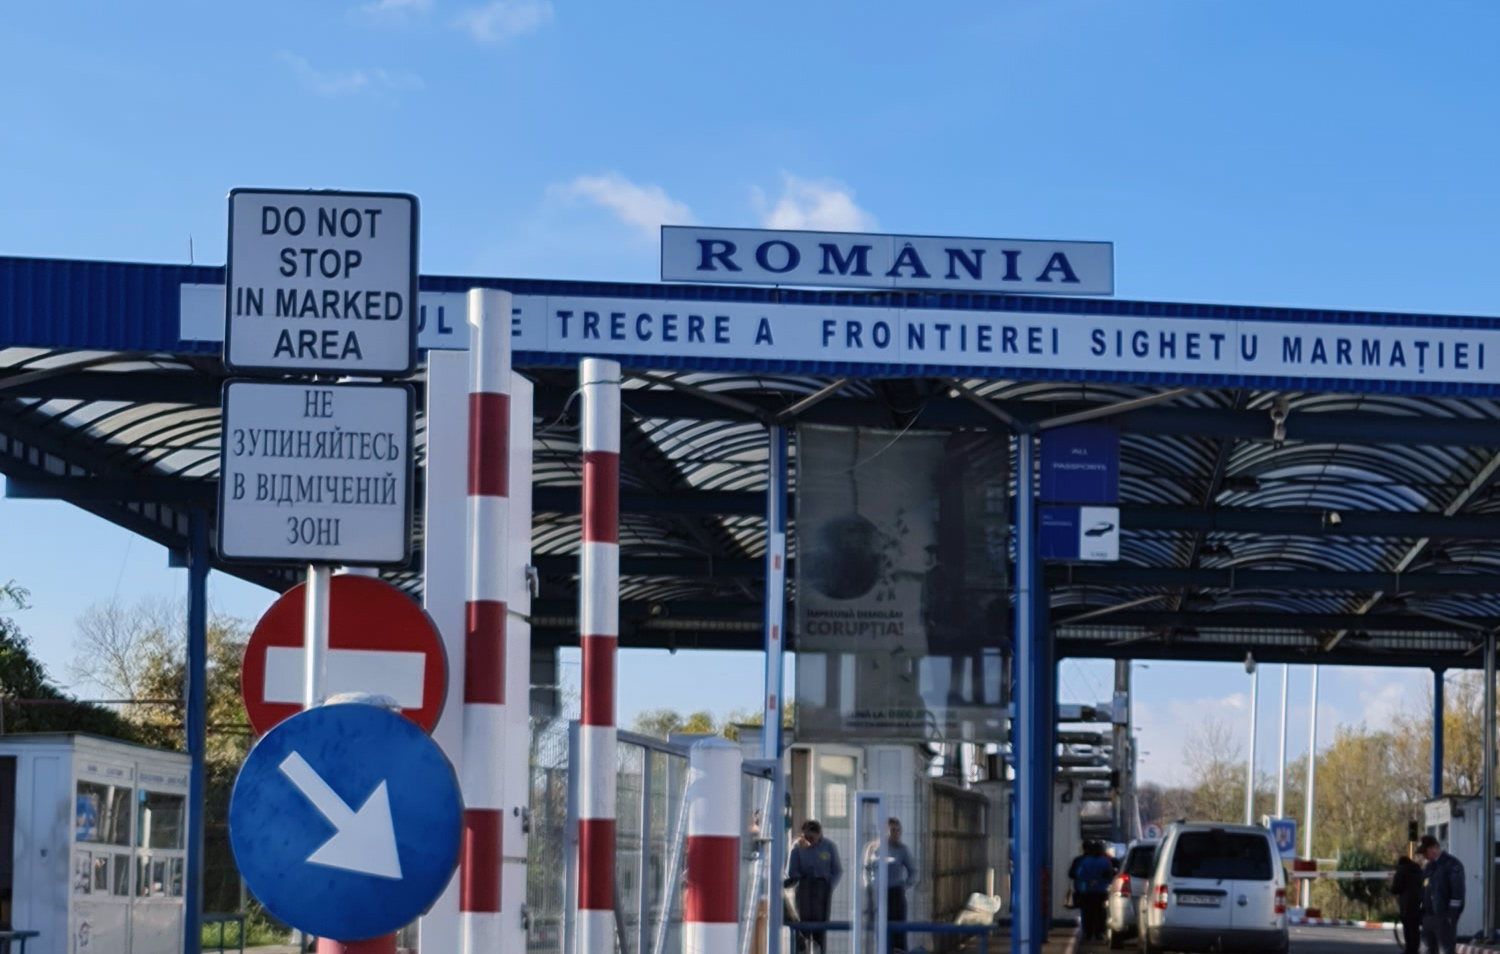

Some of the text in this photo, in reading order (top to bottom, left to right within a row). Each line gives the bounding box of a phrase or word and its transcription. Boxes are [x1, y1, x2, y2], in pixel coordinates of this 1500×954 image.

[261, 205, 382, 239] DO NOT
[279, 247, 363, 279] STOP
[696, 238, 1081, 284] ROMÂNIA
[236, 287, 404, 322] IN MARKED
[273, 328, 364, 361] AREA
[556, 310, 731, 344] TRECERE
[755, 317, 774, 346] A
[822, 319, 1059, 355] FRONTIEREI
[1283, 336, 1486, 374] MARMAȚIEI
[303, 389, 334, 419] НЕ
[232, 425, 400, 462] ЗУПИНЯЙТЕСЬ
[232, 472, 397, 507] В ВІДМІЧЕНІЙ
[286, 516, 341, 546] ЗОНІ
